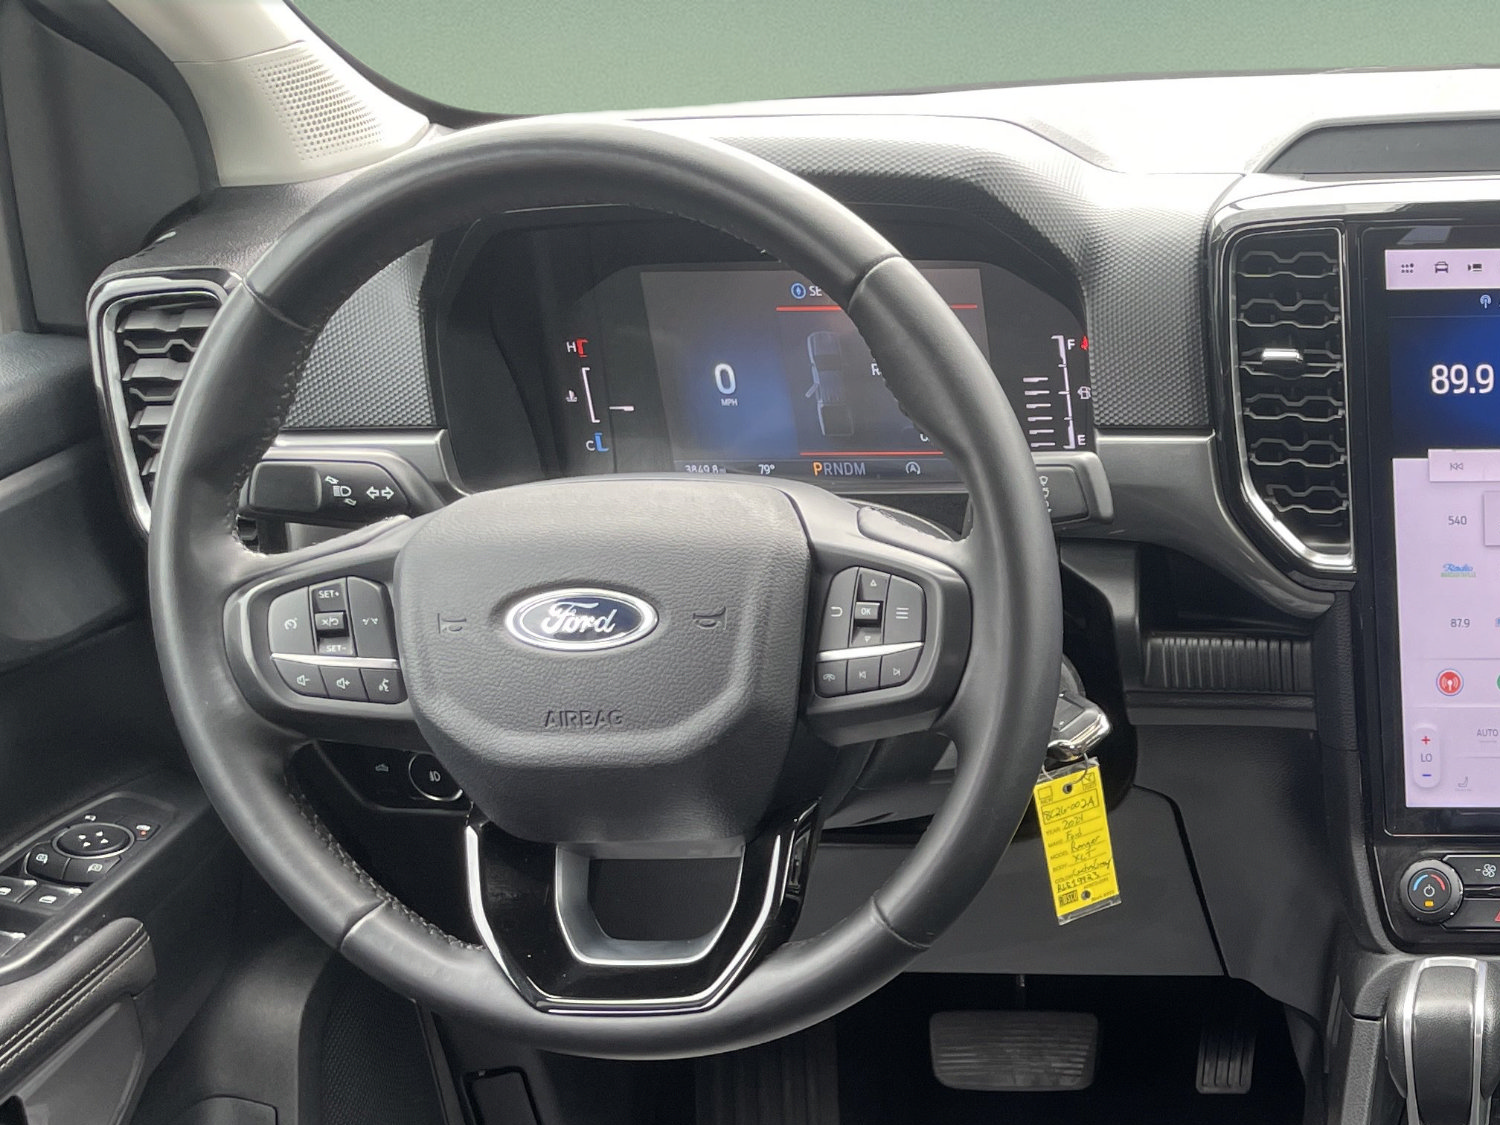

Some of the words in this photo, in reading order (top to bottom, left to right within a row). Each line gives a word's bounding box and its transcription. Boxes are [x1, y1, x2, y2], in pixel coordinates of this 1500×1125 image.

[1067, 339, 1076, 350] F
[714, 363, 737, 394] 0
[1430, 364, 1495, 394] 89.9
[720, 398, 738, 406] MPH
[1077, 434, 1086, 446] E
[684, 464, 719, 474] 38498
[1448, 515, 1467, 526] 540
[541, 601, 618, 634] Ford
[860, 608, 871, 616] OK
[1450, 618, 1471, 628] 87.9
[544, 709, 624, 728] AIRBAG
[1476, 728, 1499, 737] AUTO
[1420, 753, 1433, 762] LO
